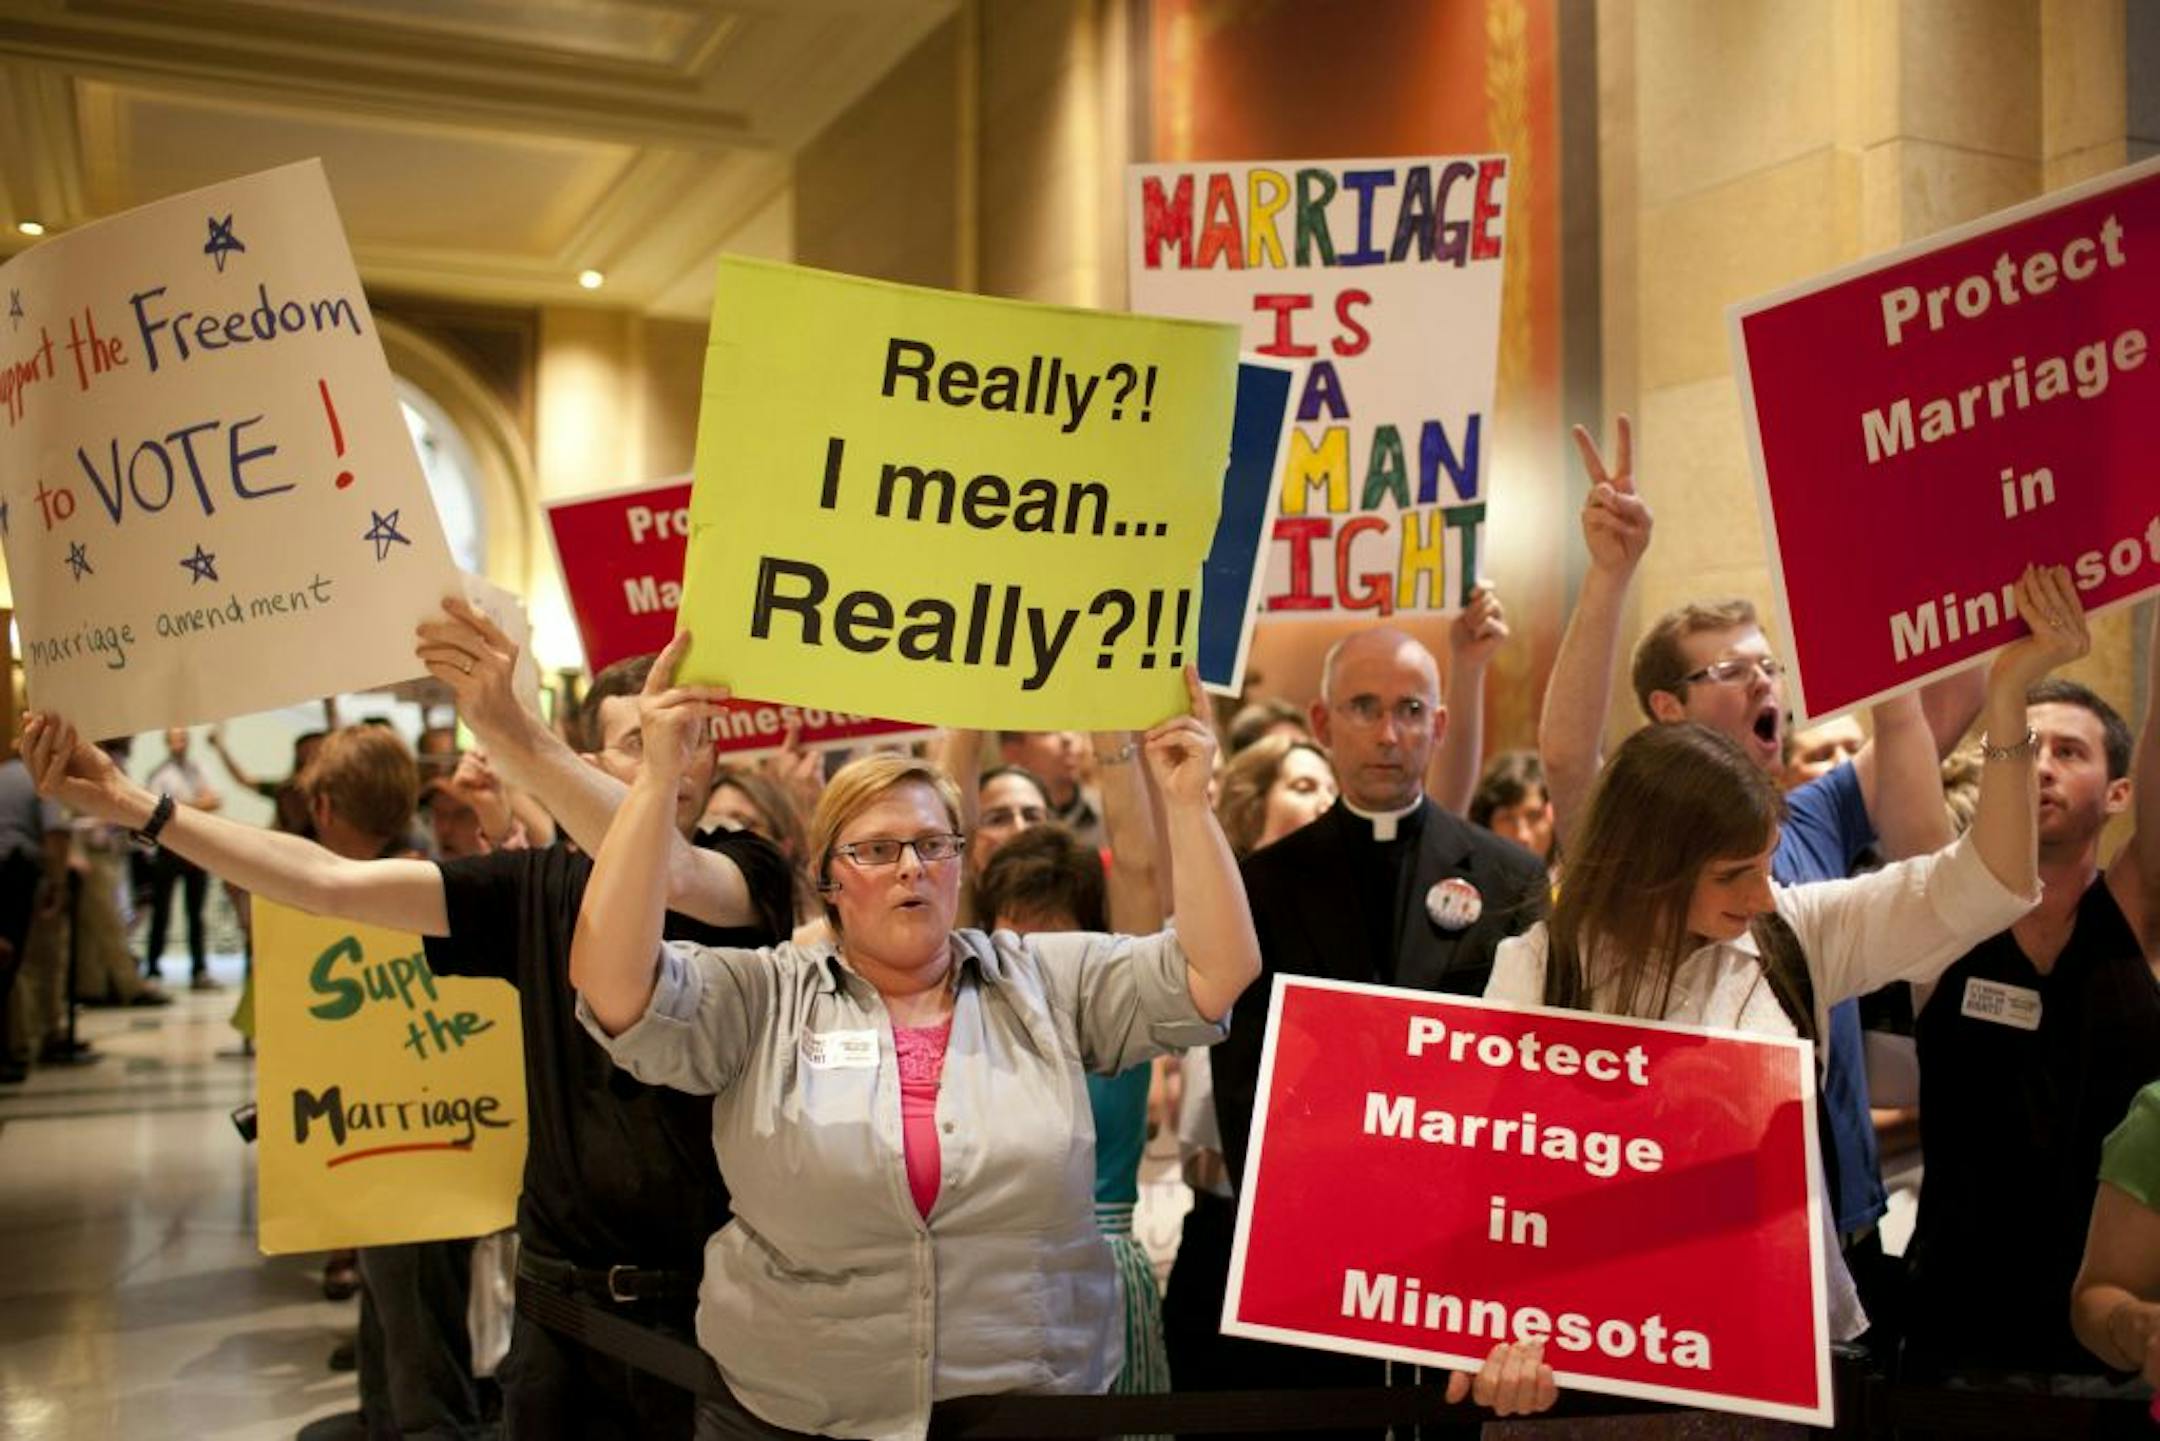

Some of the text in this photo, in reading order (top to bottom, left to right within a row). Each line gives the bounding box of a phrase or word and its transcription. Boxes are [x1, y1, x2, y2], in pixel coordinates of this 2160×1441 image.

[1142, 158, 1507, 270] MARRIAGE
[1253, 289, 1373, 359] IS
[1880, 213, 2126, 348] Protect
[66, 304, 129, 391] the
[129, 284, 362, 373] Freedom
[881, 337, 1159, 433] Really?!
[1296, 360, 1351, 421] A
[1861, 328, 2149, 464] Marriage
[34, 480, 76, 532] to
[820, 437, 1168, 538] I mean...
[1280, 414, 1482, 516] MAN
[2000, 467, 2056, 520] in
[1266, 504, 1487, 618] IGHT
[30, 573, 333, 670] marriage amendment
[750, 555, 1191, 690] Really?!!
[404, 1009, 496, 1060] the
[1406, 1015, 1650, 1087] Protect
[292, 1085, 516, 1146] Marriage
[1363, 1091, 1665, 1178] Marriage
[1488, 1196, 1548, 1248] in
[1340, 1269, 1713, 1372] Minnesota
